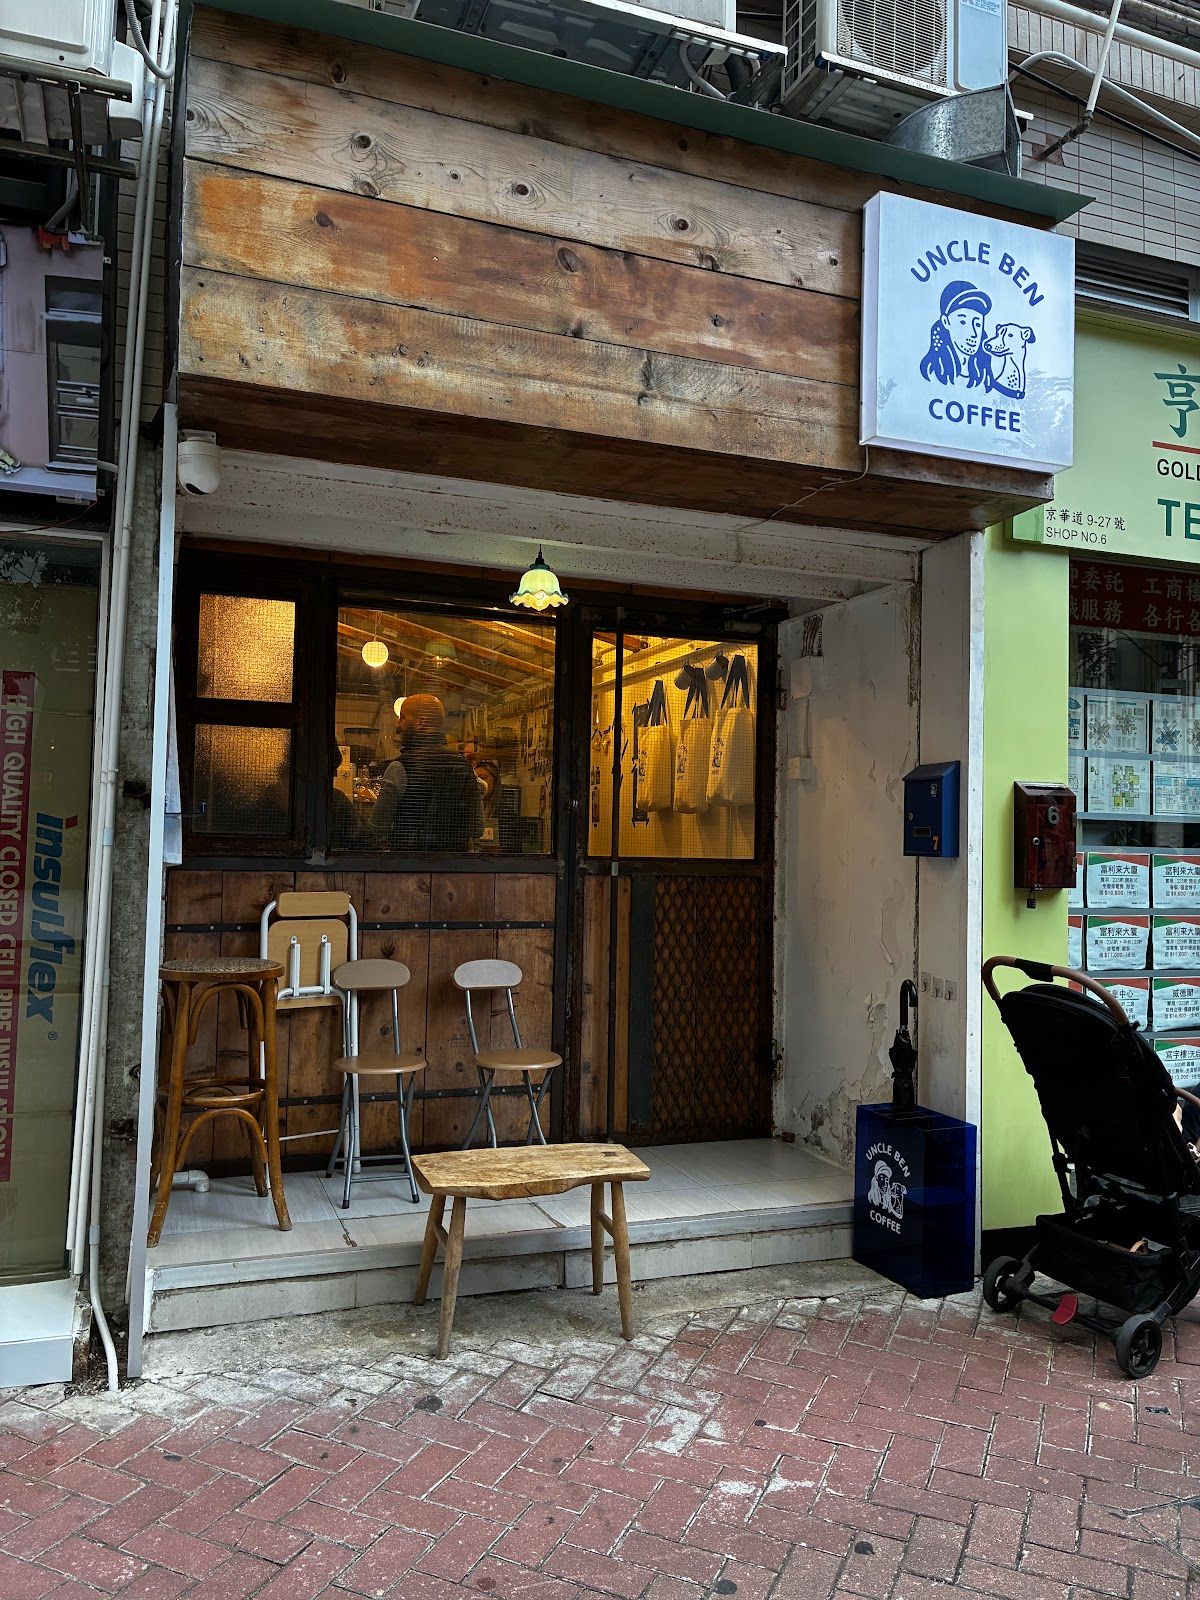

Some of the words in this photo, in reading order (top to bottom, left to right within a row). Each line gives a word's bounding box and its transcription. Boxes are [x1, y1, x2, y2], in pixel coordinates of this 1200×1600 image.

[910, 239, 991, 283] UNCLE
[998, 252, 1045, 307] BEN
[928, 398, 1021, 433] COFFEE
[1045, 526, 1078, 543] SHOP
[1081, 530, 1107, 545] NO.6
[0, 751, 26, 841] QUALITY
[1048, 806, 1060, 825] 6
[932, 835, 939, 850] 7
[0, 846, 20, 926] CLOSED
[865, 1142, 893, 1161] UNCLE
[893, 1150, 911, 1178] BEN
[869, 1209, 901, 1235] COFFEE
